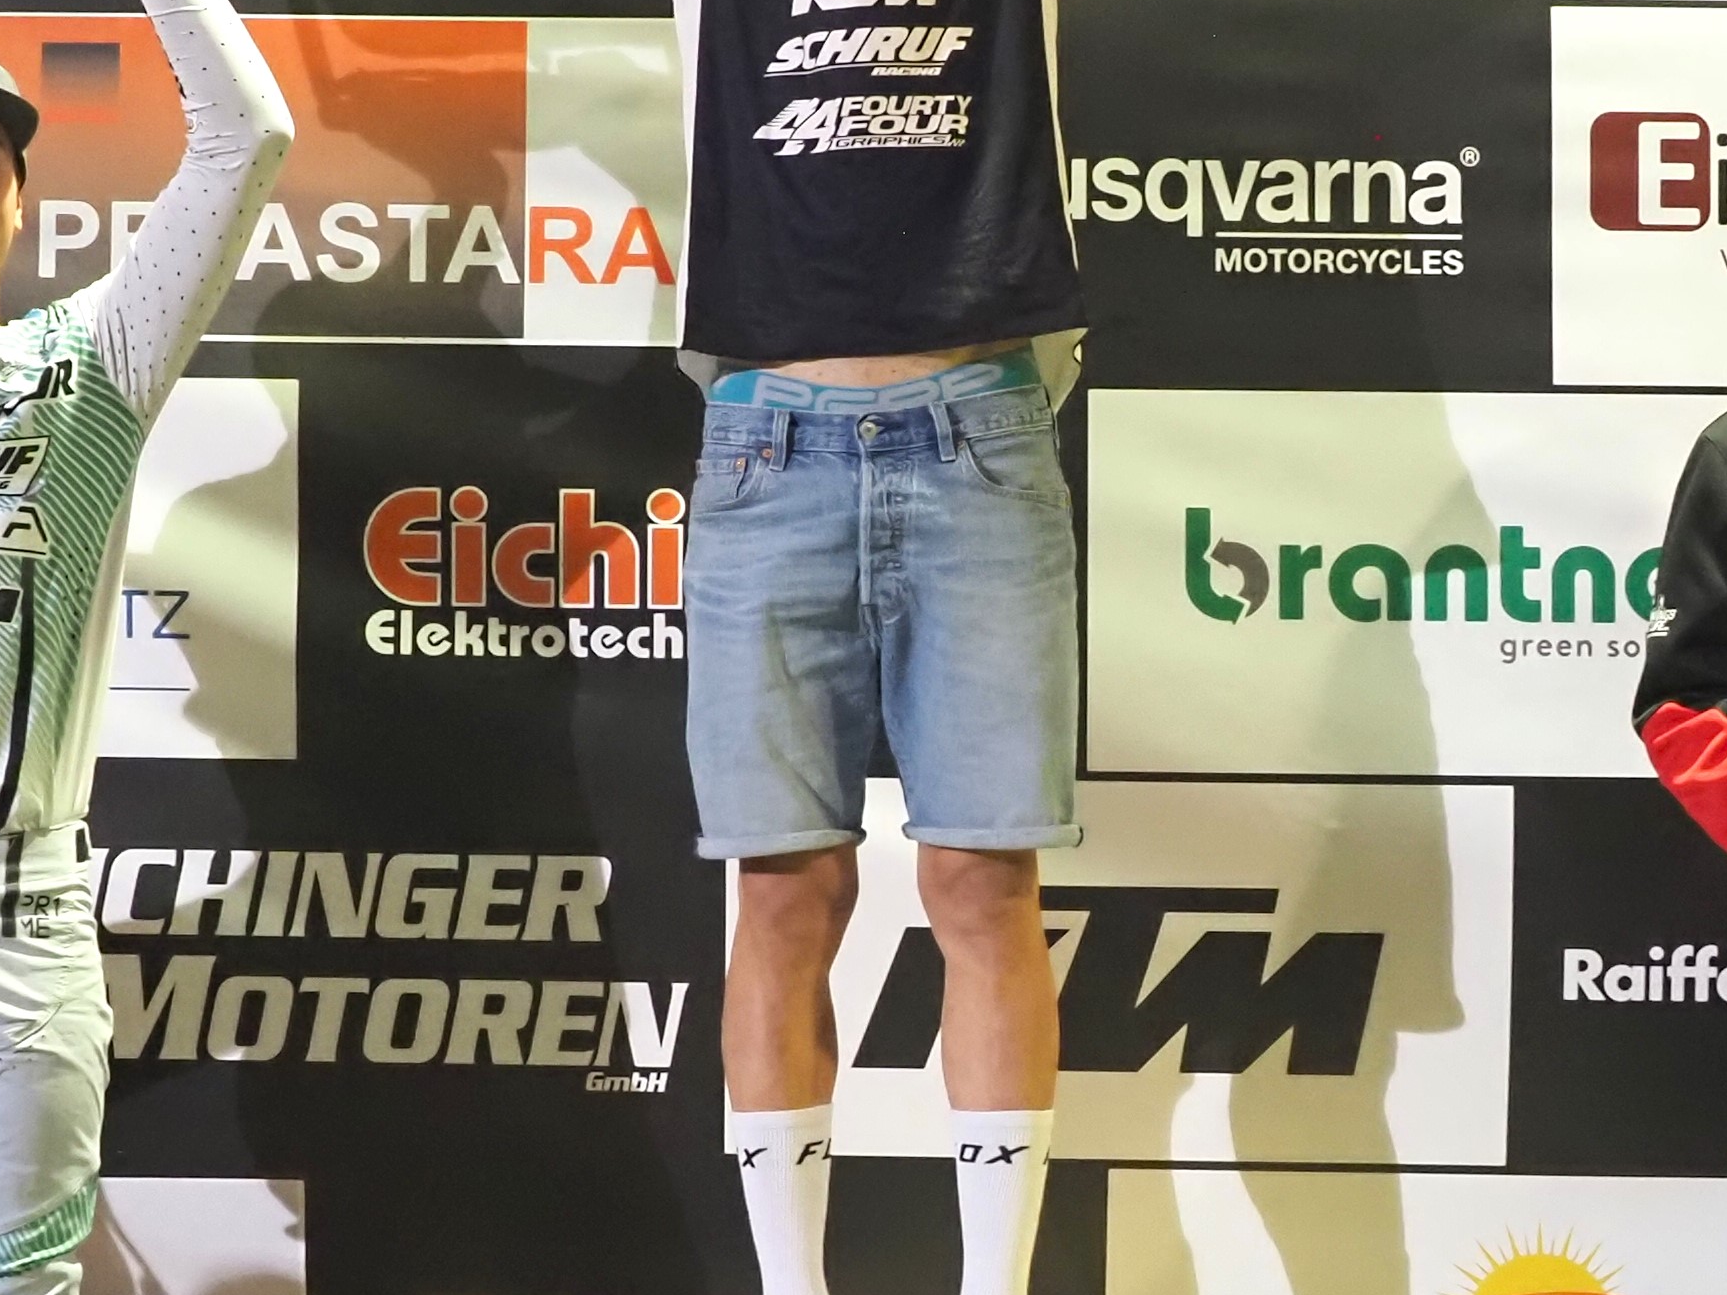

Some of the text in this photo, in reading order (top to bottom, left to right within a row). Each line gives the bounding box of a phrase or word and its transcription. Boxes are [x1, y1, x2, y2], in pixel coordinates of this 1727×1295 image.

[765, 26, 974, 75] SCHRUF
[834, 114, 970, 135] FOUR
[840, 95, 972, 116] FOURTY
[37, 199, 677, 286] PFASTARA
[1214, 247, 1464, 276] MOTORCYCLES
[363, 485, 686, 611] Eichi
[365, 610, 684, 660] Elektrotech
[1500, 637, 1592, 664] green
[88, 847, 612, 942] CHINGER
[585, 1071, 669, 1093] GmbH
